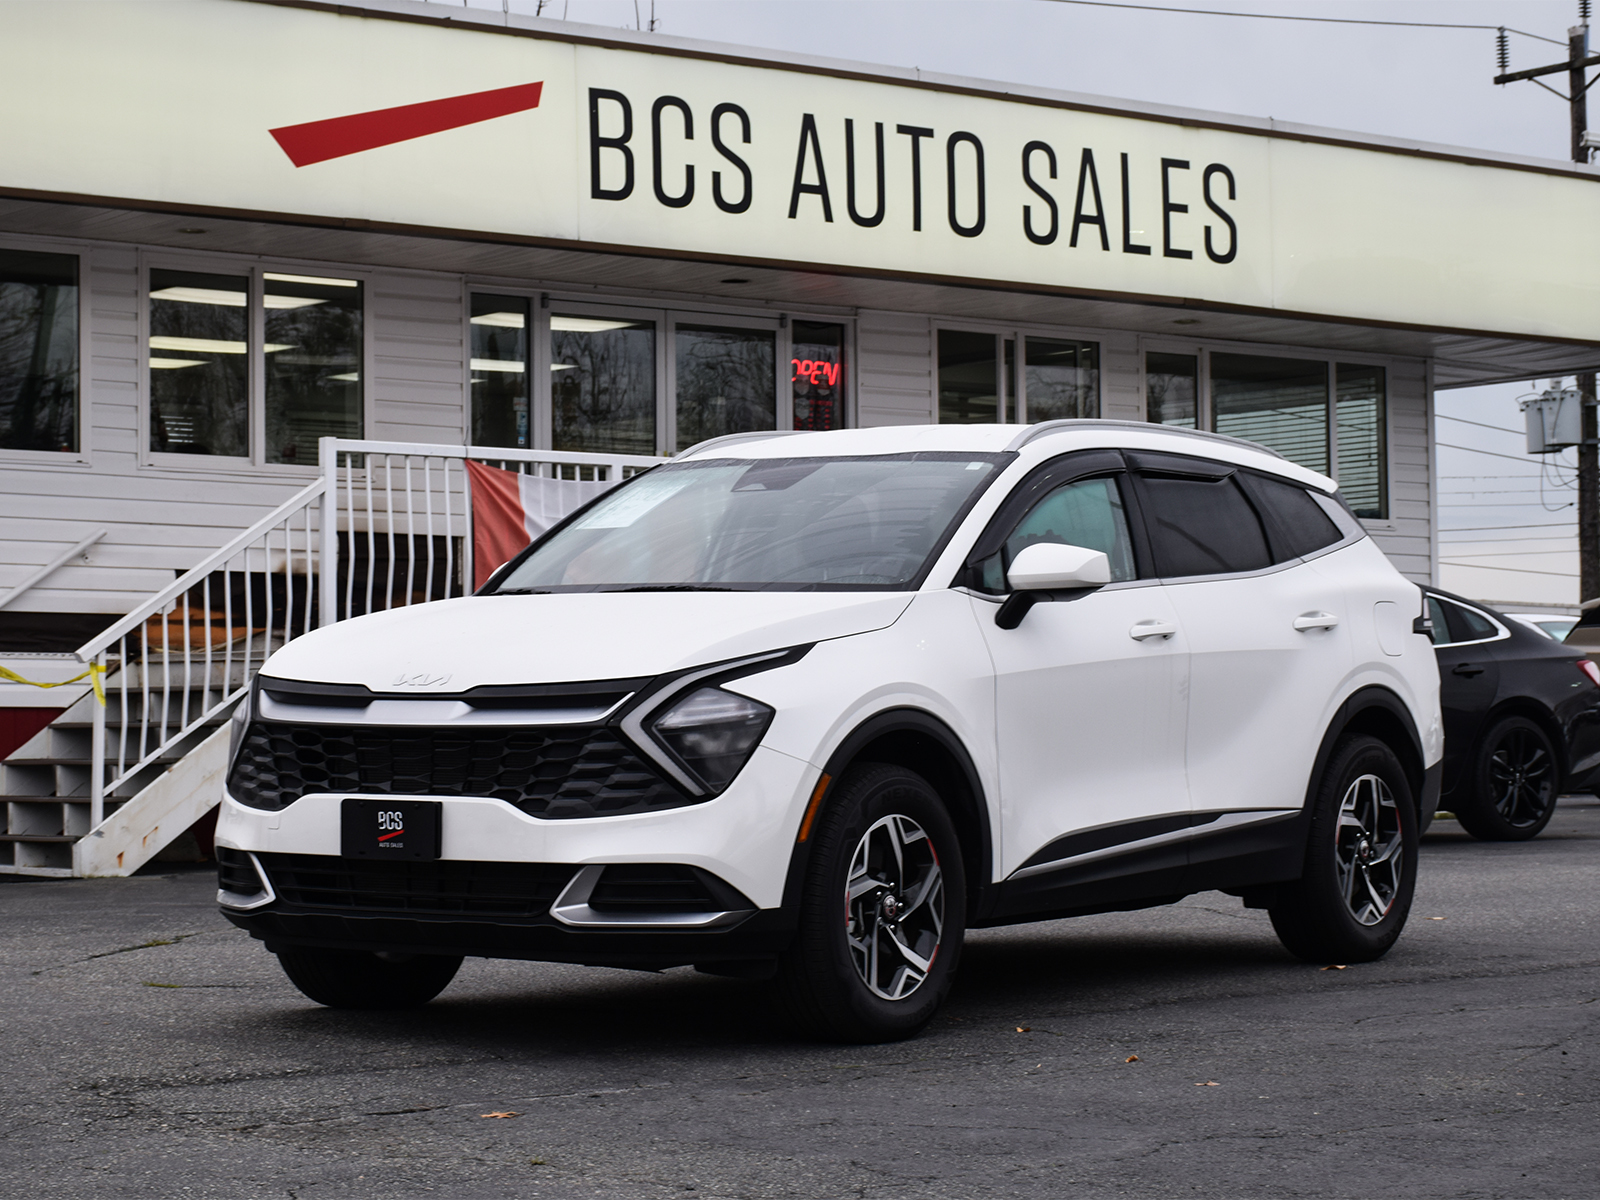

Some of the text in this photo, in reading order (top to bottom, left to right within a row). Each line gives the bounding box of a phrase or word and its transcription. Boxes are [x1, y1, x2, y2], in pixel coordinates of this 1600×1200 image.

[589, 88, 1238, 265] BCS AUTO SALES
[791, 359, 839, 385] OPEN
[377, 811, 404, 831] BCS
